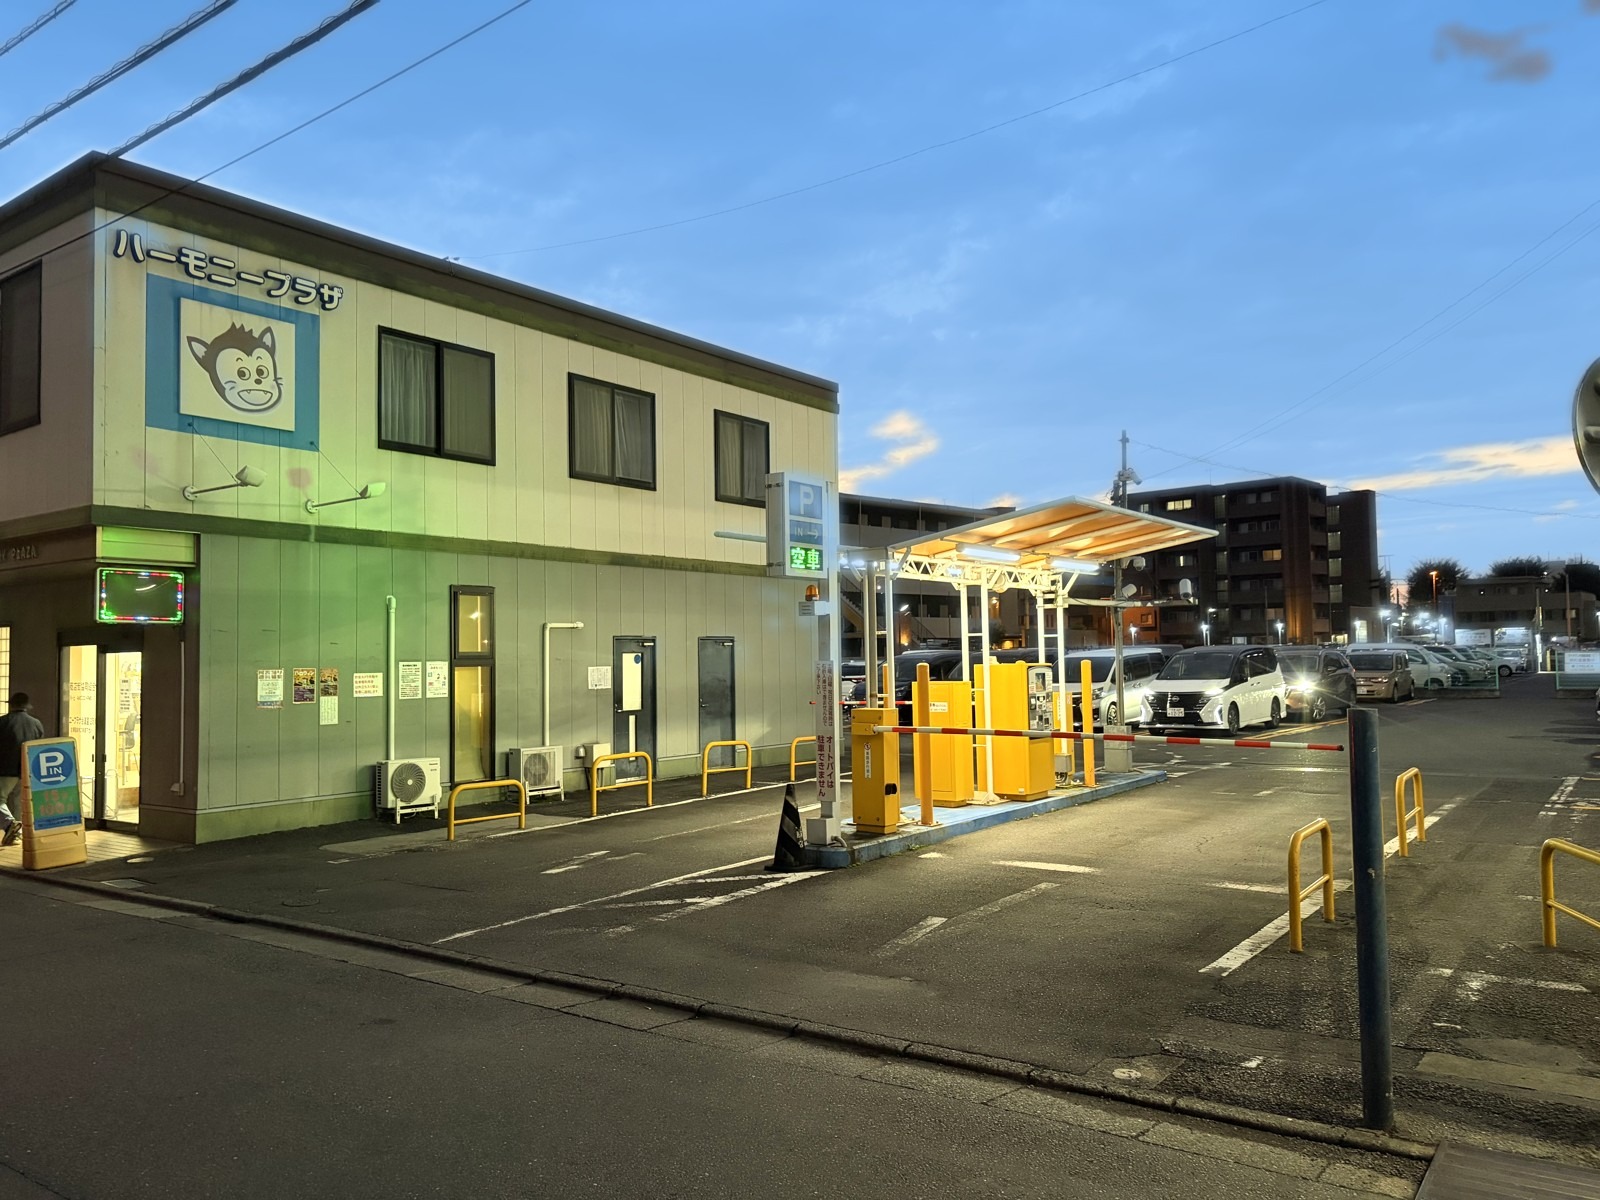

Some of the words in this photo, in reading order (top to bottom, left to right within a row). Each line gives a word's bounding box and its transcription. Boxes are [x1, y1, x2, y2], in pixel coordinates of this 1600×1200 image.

[112, 229, 344, 311] ハーモニープラザ
[799, 484, 814, 515] P
[794, 526, 804, 537] IN
[791, 547, 820, 570] 空車
[39, 751, 65, 776] P
[49, 766, 63, 775] IN
[817, 735, 826, 797] 駐車できません
[826, 736, 834, 789] オートバイは
